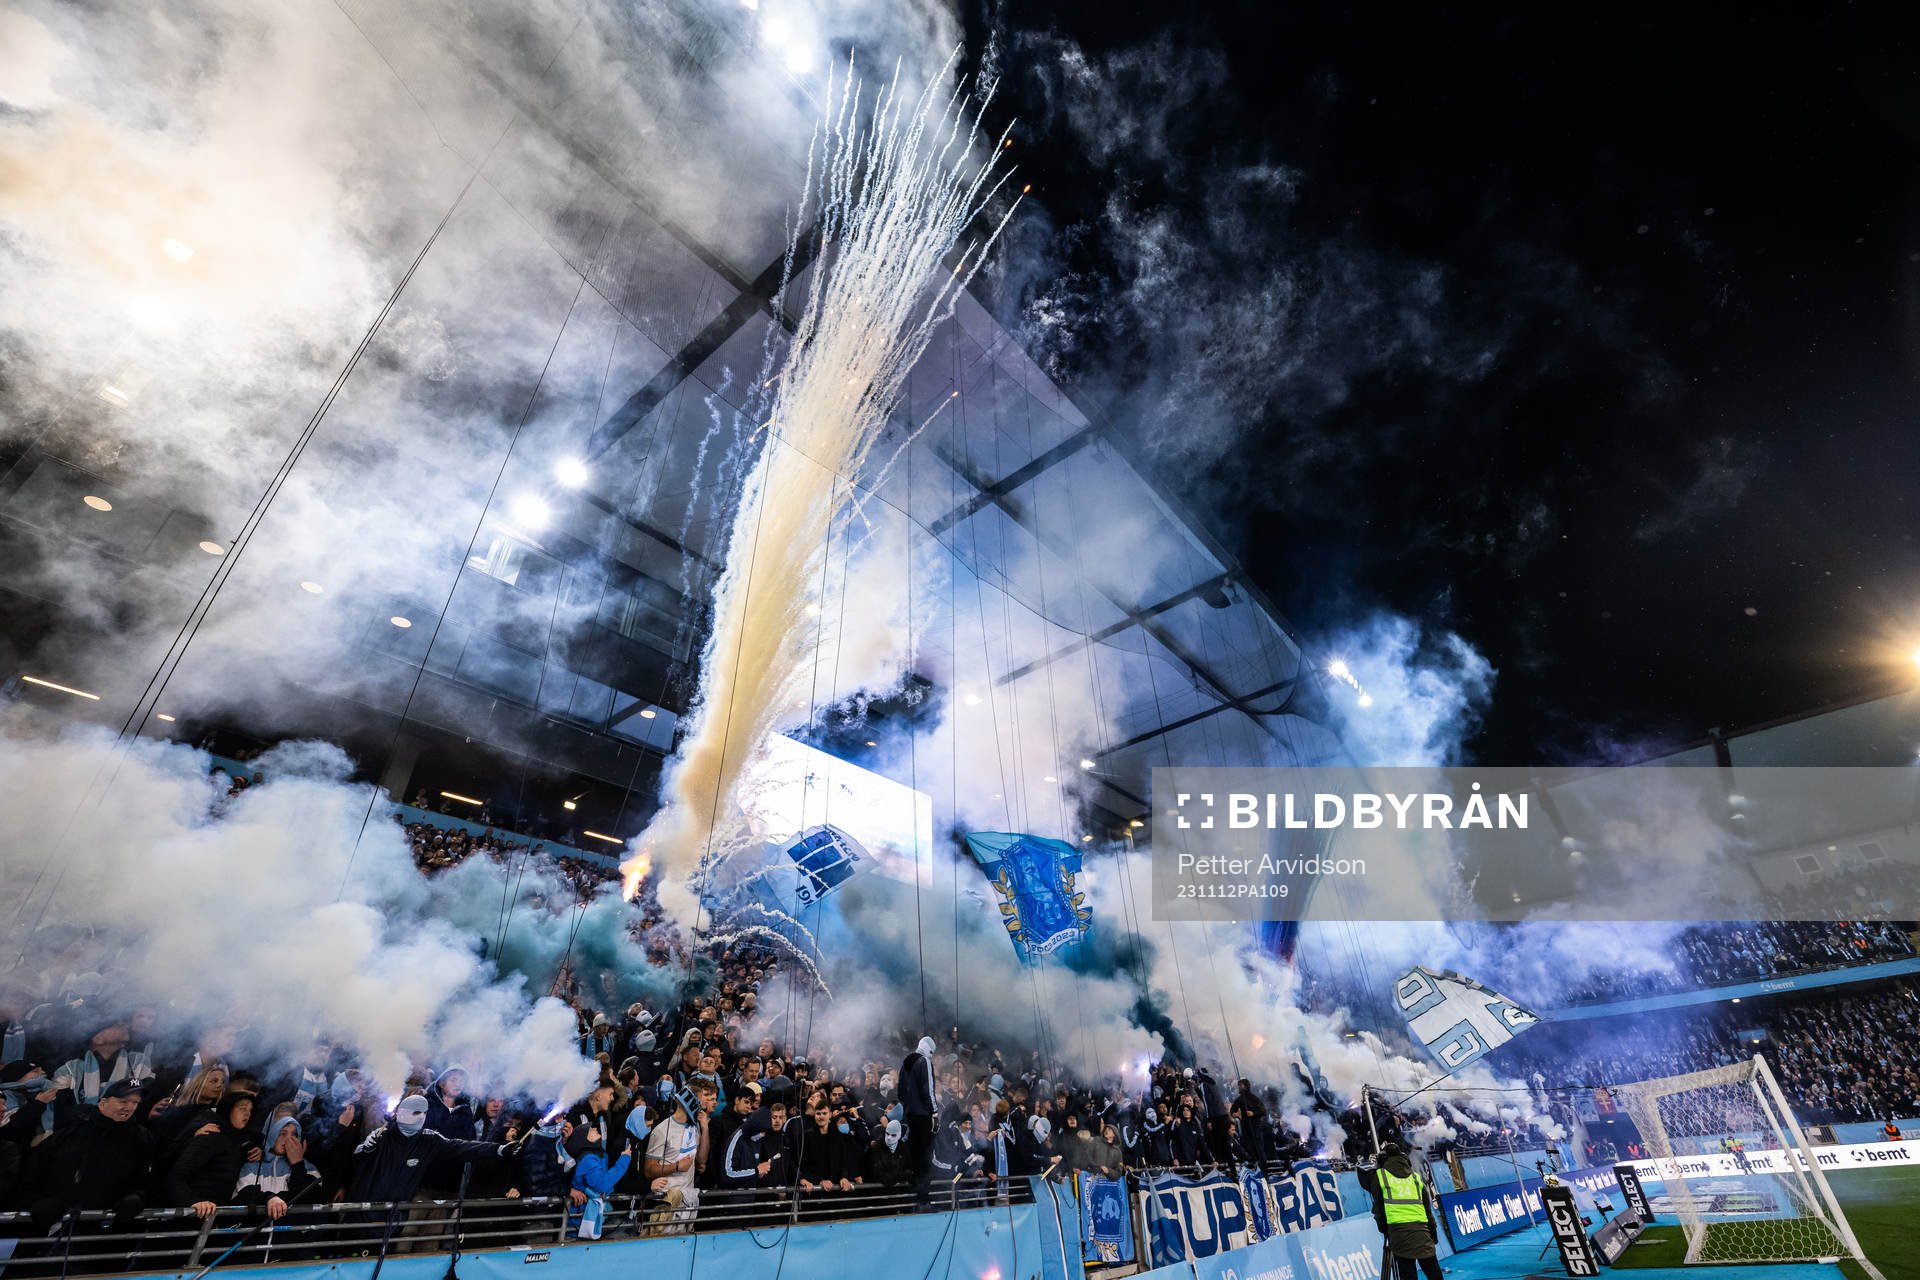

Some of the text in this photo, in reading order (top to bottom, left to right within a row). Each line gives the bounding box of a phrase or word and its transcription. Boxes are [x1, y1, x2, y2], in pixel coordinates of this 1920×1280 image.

[1797, 1152, 1840, 1166] bmt
[1865, 1147, 1910, 1161] bemt
[1733, 1156, 1773, 1170] bmt
[1636, 1166, 1657, 1177] emt
[1397, 1186, 1411, 1196] 24
[1620, 1173, 1647, 1216] SELECT
[1547, 1199, 1591, 1275] SELECT
